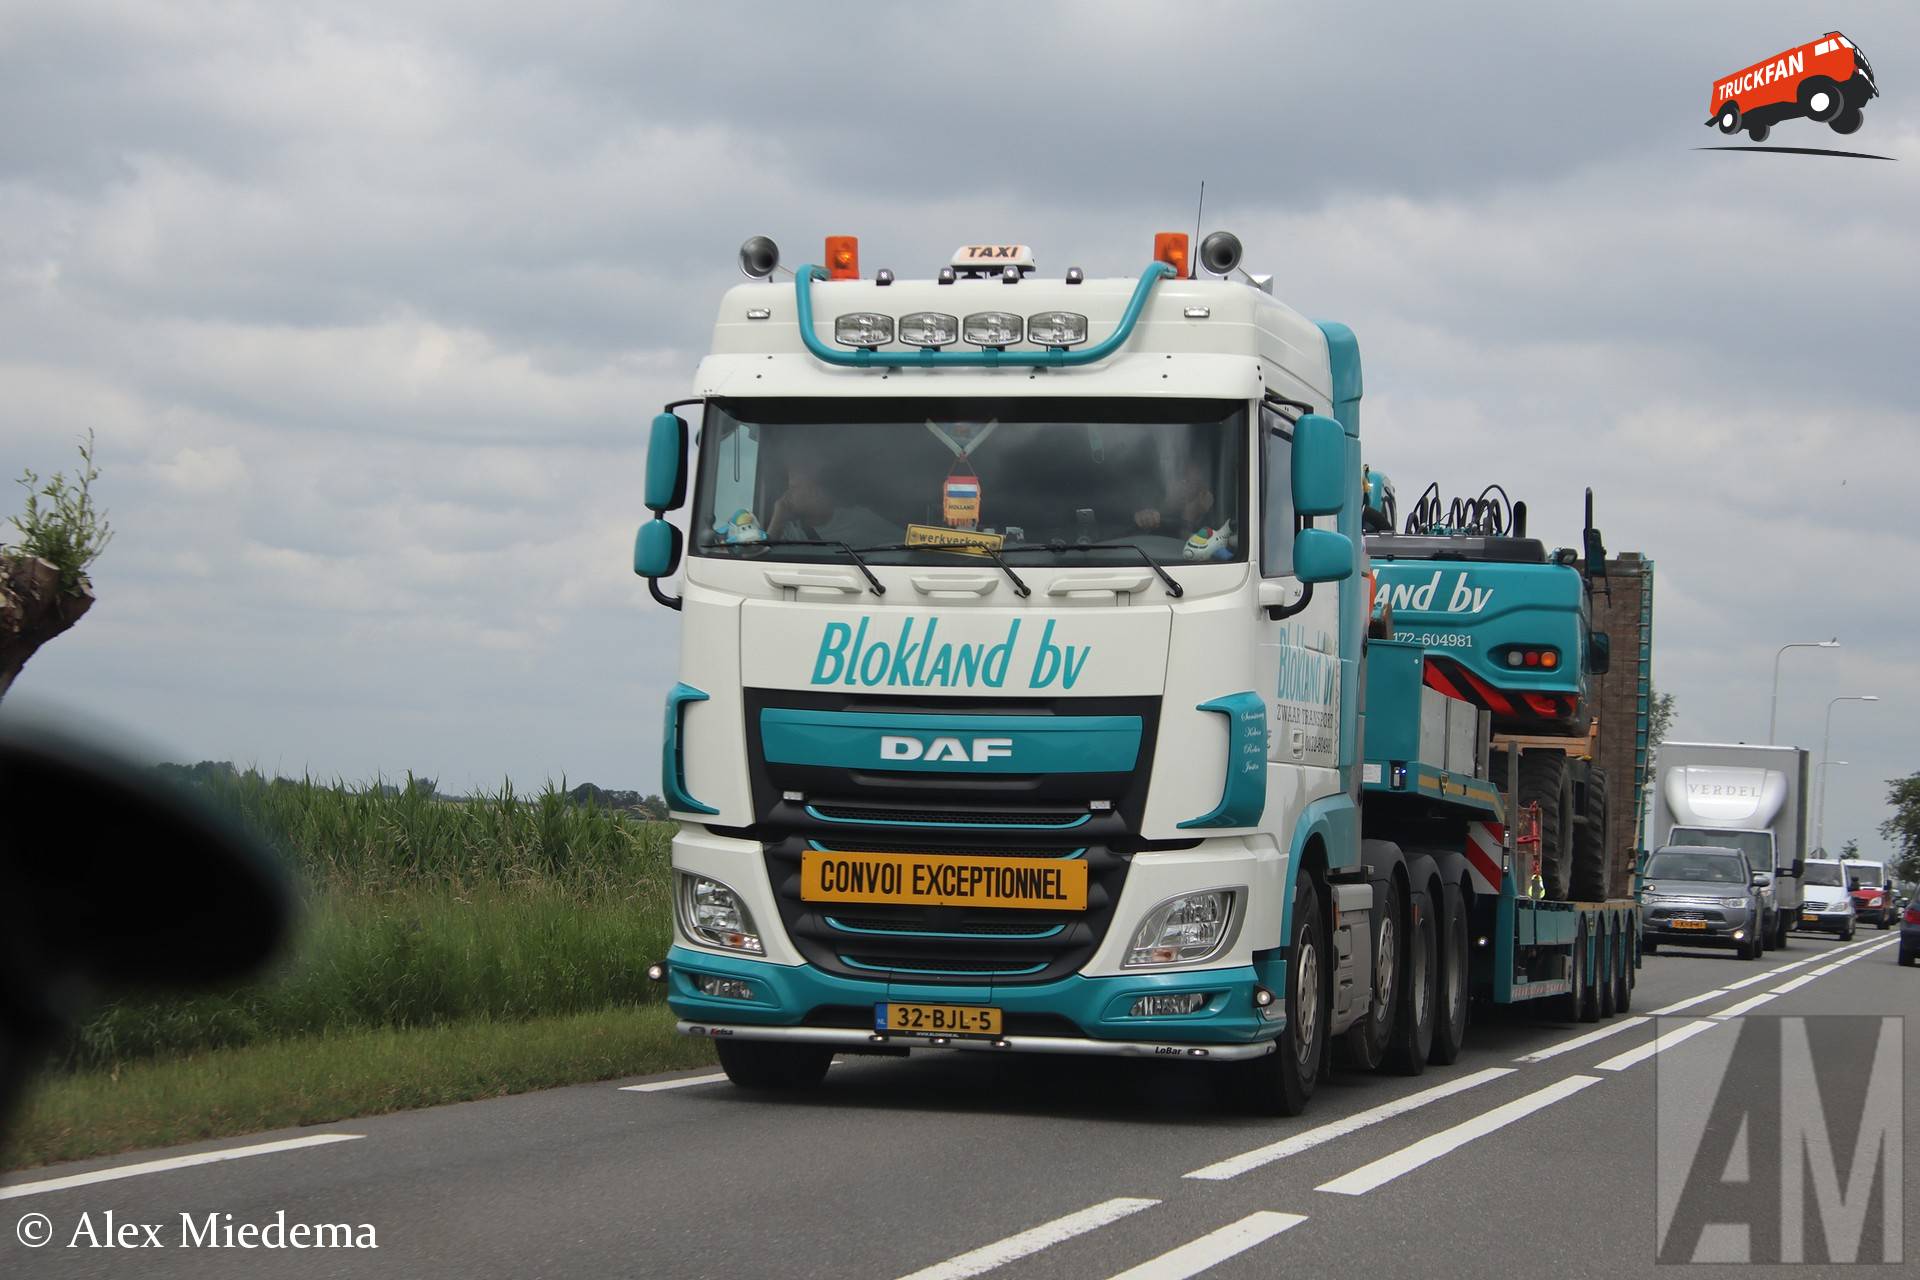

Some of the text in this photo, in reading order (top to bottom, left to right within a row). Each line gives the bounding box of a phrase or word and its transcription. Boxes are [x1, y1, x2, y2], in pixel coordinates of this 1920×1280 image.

[968, 247, 1018, 258] TAXI
[1447, 572, 1494, 613] bv
[1028, 619, 1091, 690] bv
[880, 736, 1013, 763] DAF
[1688, 783, 1760, 798] VERDEL
[820, 860, 1067, 901] CONVOI EXCEPTIONNEL
[897, 1007, 991, 1031] 32-BJL-5
[1155, 1046, 1182, 1055] LoBar
